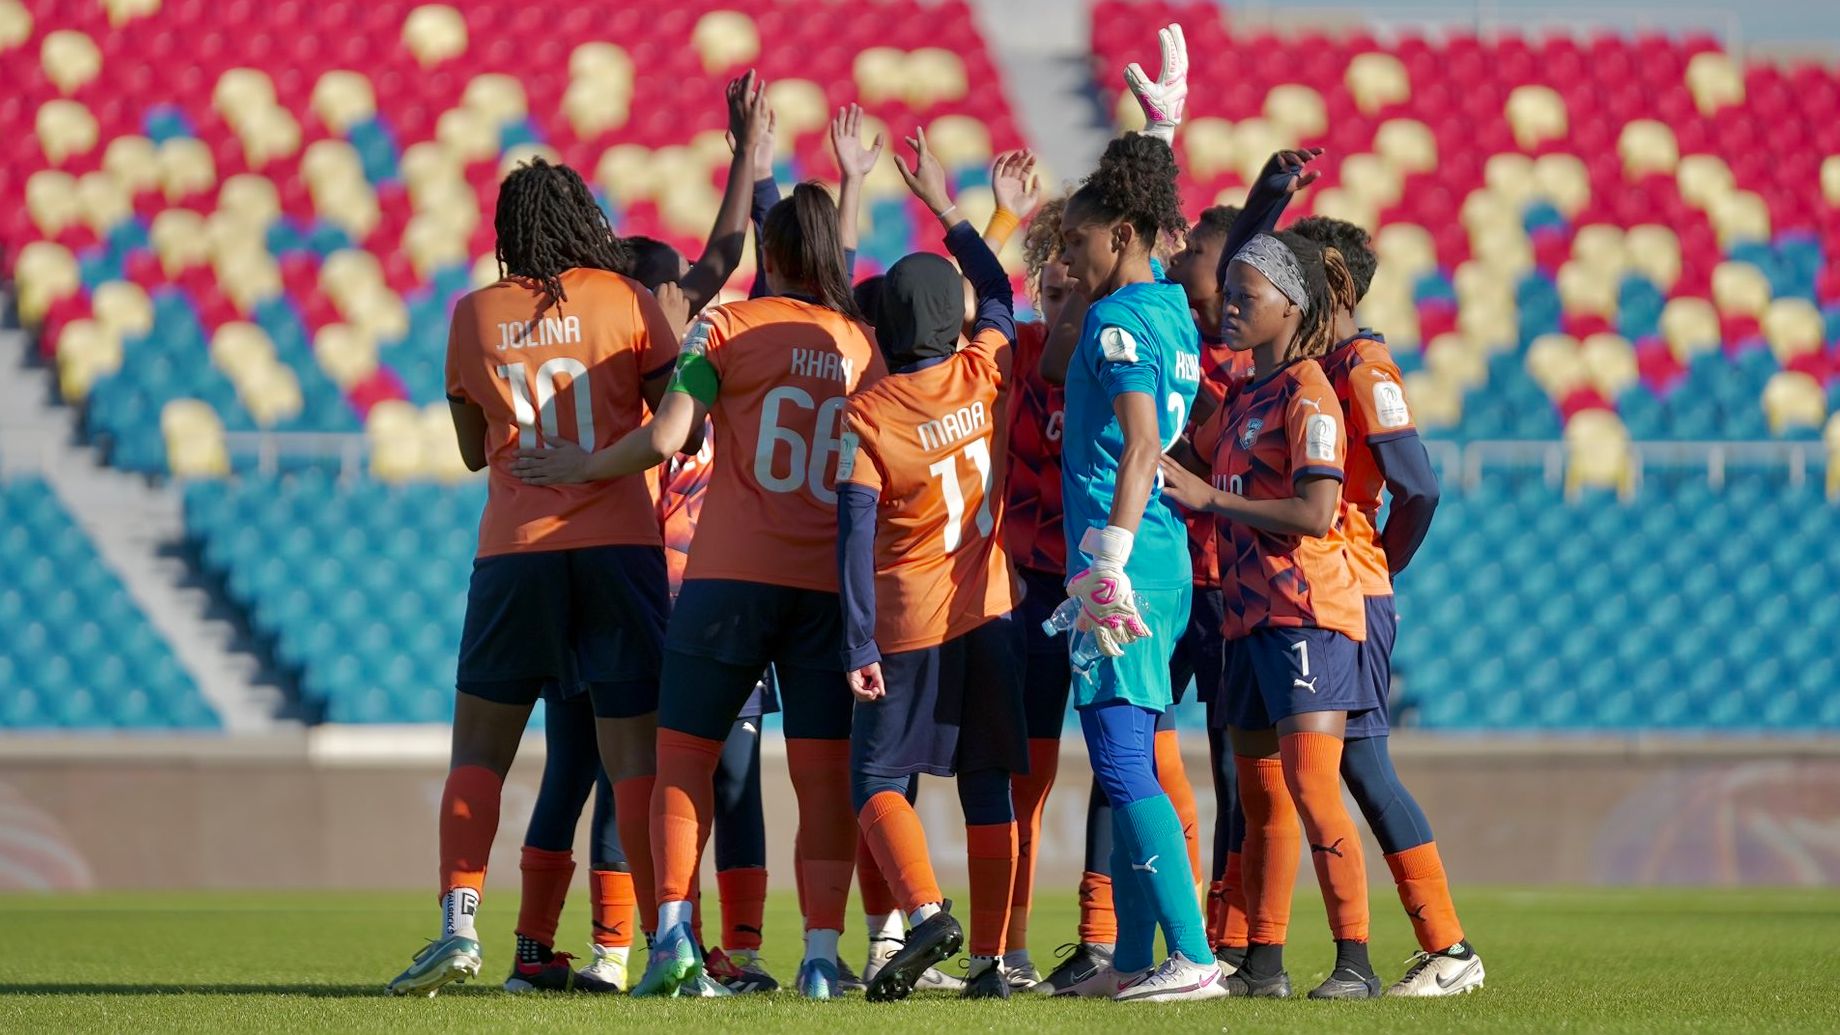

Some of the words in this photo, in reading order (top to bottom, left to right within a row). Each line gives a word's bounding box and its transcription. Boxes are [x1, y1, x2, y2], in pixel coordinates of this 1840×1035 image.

[497, 315, 581, 350] JOLINA
[790, 347, 854, 386] KHAN
[497, 357, 595, 454] 10
[916, 400, 986, 452] MADA
[929, 437, 994, 553] 11
